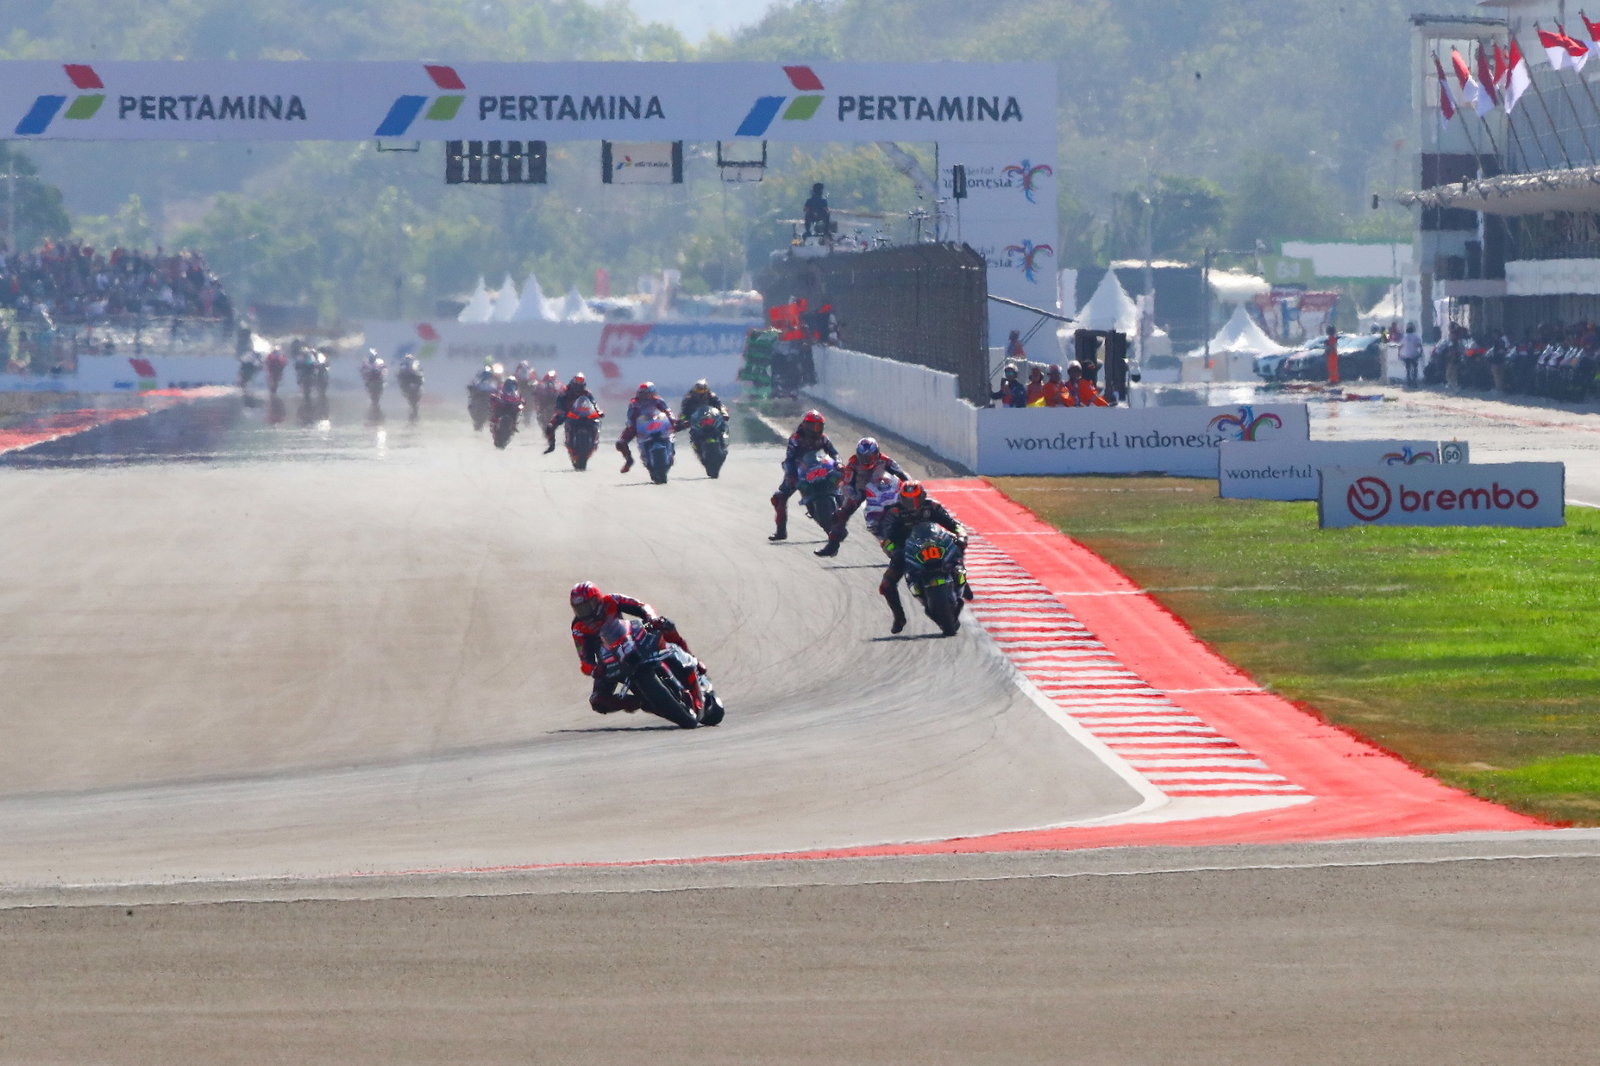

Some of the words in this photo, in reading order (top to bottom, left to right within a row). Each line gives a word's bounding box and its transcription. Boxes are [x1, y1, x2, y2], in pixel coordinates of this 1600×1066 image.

[118, 95, 307, 121] PERTAMINA
[478, 95, 666, 121] PERTAMINA
[837, 95, 1024, 122] PERTAMINA
[1005, 431, 1119, 450] wonderful
[1224, 464, 1313, 479] wonderful
[1399, 481, 1539, 512] brembo
[921, 546, 941, 561] 10
